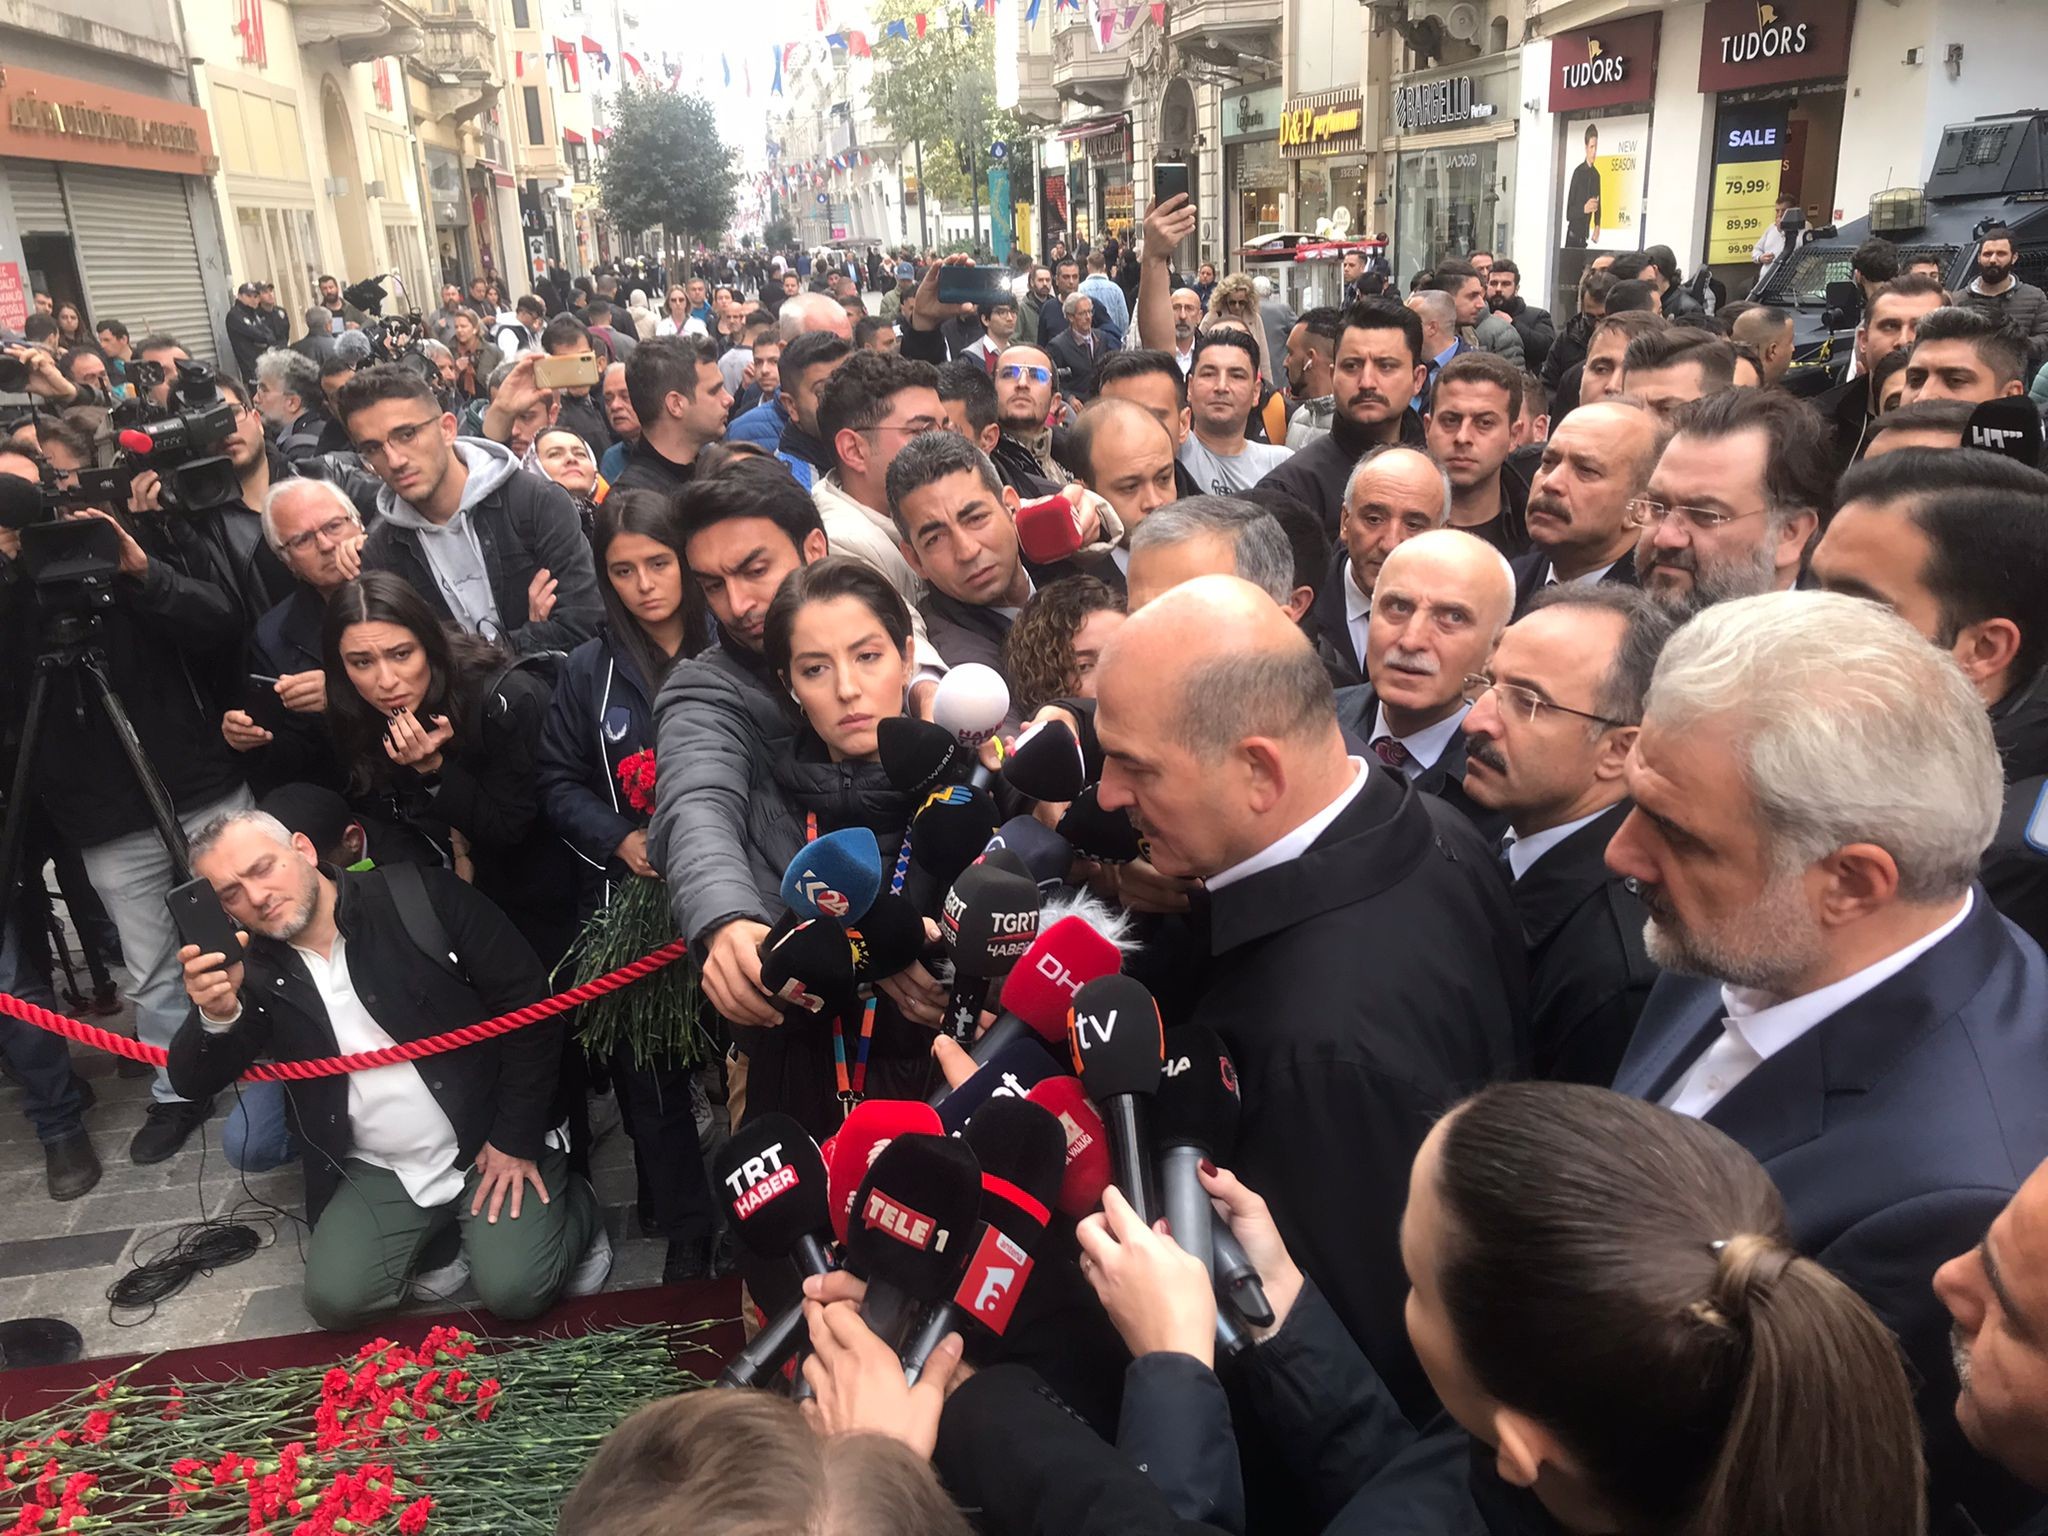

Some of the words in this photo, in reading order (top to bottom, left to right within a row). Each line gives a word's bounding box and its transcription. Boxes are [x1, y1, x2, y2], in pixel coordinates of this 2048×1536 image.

[1720, 23, 1807, 64] TUDORS
[1562, 55, 1624, 89] TUDORS
[1405, 75, 1471, 128] BARGELLO
[1279, 107, 1312, 146] D&P
[1617, 140, 1638, 153] NEW
[1728, 128, 1777, 147] SALE
[1611, 157, 1636, 172] SEASON
[991, 910, 1039, 934] TGRT
[1036, 952, 1086, 999] DH
[1075, 1010, 1118, 1050] tv
[725, 1142, 783, 1198] TRT
[736, 1168, 796, 1218] HABER
[868, 1194, 931, 1246] TELE
[934, 1228, 950, 1254] 1
